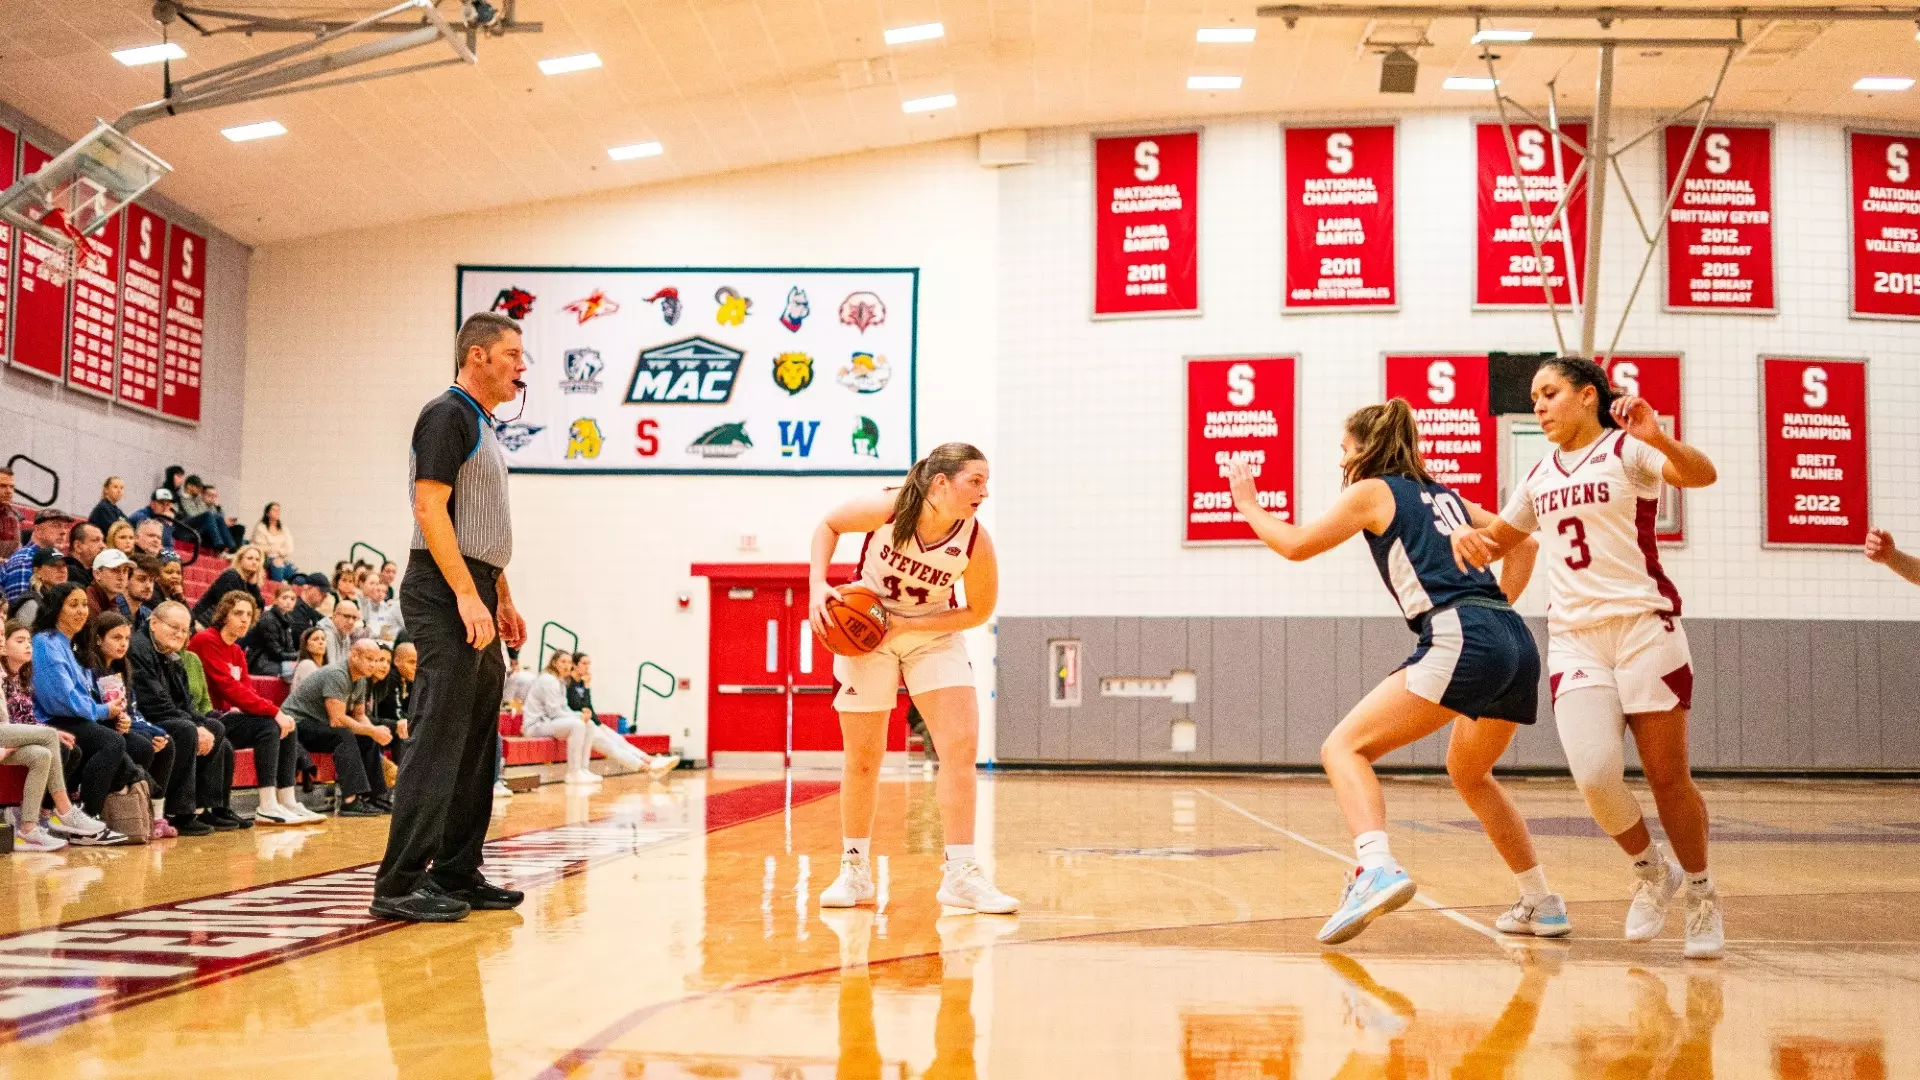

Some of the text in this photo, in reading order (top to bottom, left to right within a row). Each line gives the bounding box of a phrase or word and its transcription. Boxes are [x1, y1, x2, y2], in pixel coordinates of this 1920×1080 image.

[1326, 132, 1353, 174] S
[1518, 129, 1545, 170] S
[1706, 133, 1731, 174] S
[1134, 141, 1160, 181] S
[1886, 142, 1910, 183] S
[1113, 184, 1180, 200] NATIONAL
[1304, 178, 1376, 192] NATIONAL
[1686, 178, 1753, 192] NATIONAL
[1303, 190, 1378, 206] CHAMPION
[1494, 188, 1559, 202] CHAMPIO
[1684, 192, 1756, 206] CHAMPION
[1869, 186, 1920, 201] NATIONA
[1111, 197, 1182, 214] CHAMPION
[1863, 200, 1920, 214] CHAMPIO
[1671, 209, 1728, 224] BRITTANY
[1126, 224, 1168, 239] LAURA
[1318, 218, 1362, 232] LAURA
[1882, 226, 1918, 240] MEN'S
[1702, 228, 1738, 243] 2012
[1866, 239, 1920, 253] VOLLEYBA
[1127, 263, 1166, 282] 2011
[1320, 258, 1360, 276] 2011
[1702, 262, 1740, 277] 2015
[632, 370, 733, 400] MAC
[1227, 363, 1255, 406] S
[1427, 360, 1456, 404] S
[1802, 366, 1828, 408] S
[1206, 410, 1276, 424] NATIONAL
[1784, 413, 1849, 426] NATIONAL
[636, 418, 659, 457] S
[778, 421, 820, 456] W
[1204, 423, 1278, 438] CHAMPION
[1782, 426, 1851, 440] CHAMPION
[1796, 454, 1836, 466] BRETT
[1791, 468, 1842, 480] KALINER
[1193, 490, 1287, 509] 2015 016
[1534, 482, 1610, 516] STEVENS
[1795, 495, 1840, 512] 2022
[1421, 492, 1466, 536] 30
[1808, 516, 1848, 526] POUNDS
[1558, 516, 1592, 570] 3
[880, 544, 952, 587] STEVENS
[845, 616, 868, 637] THE
